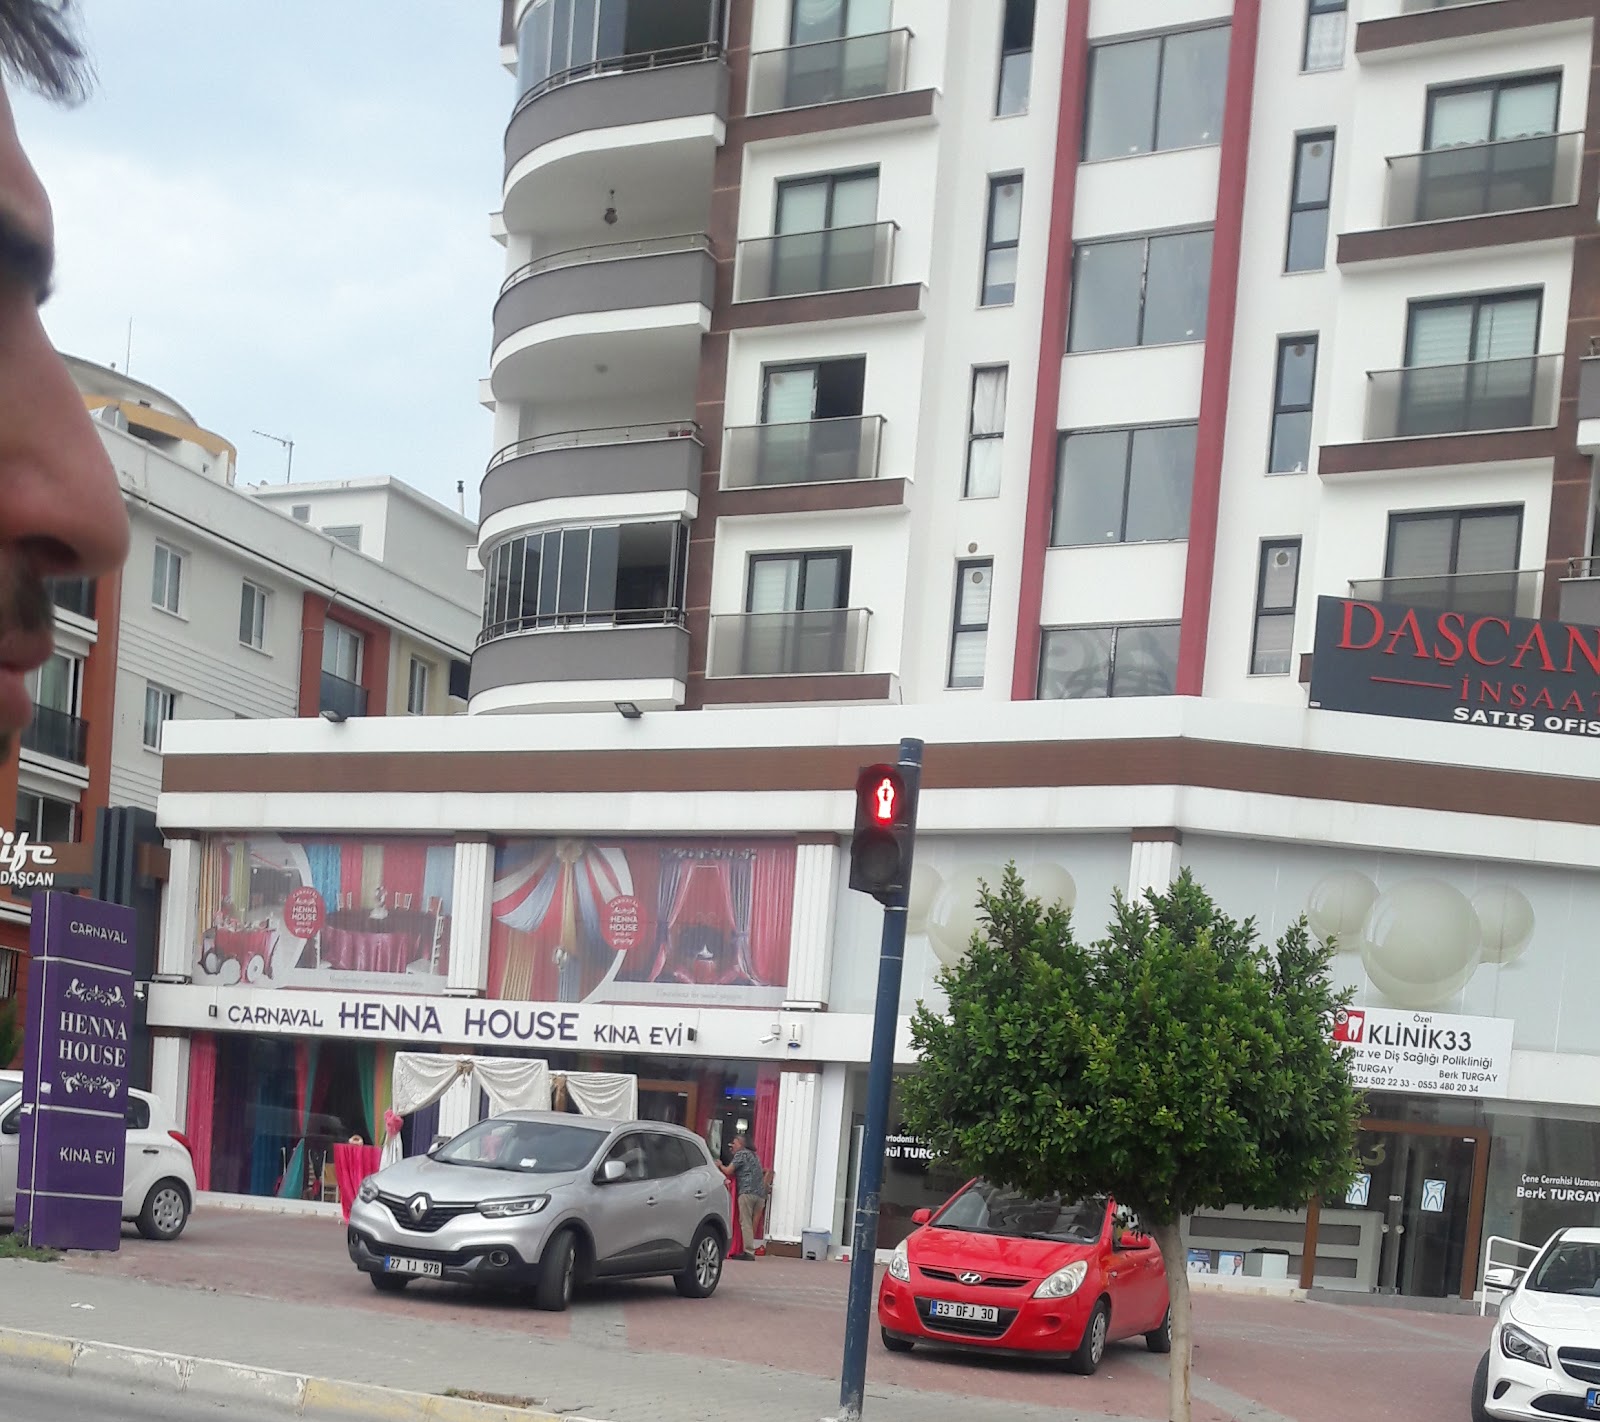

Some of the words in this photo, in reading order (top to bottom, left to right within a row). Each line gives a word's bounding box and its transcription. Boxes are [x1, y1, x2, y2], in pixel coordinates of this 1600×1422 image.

[1336, 600, 1600, 676] DAŞCAN
[1453, 707, 1534, 731] SATIŞ
[0, 827, 57, 872] ife
[0, 870, 54, 889] DAŞCAN
[70, 920, 128, 944] CARNAVAL
[60, 1010, 127, 1040] HENNA
[228, 1005, 323, 1027] CARNAVAL
[339, 1001, 442, 1034] HENNA
[464, 1007, 580, 1041] HOUSE
[594, 1023, 641, 1045] KINA
[650, 1022, 683, 1046] EVİ
[1413, 1013, 1433, 1024] Özel
[1368, 1022, 1472, 1051] KLİNİK33
[59, 1038, 127, 1068] HOUSE
[1367, 1050, 1381, 1059] ve
[1384, 1050, 1400, 1063] Diş
[1403, 1051, 1439, 1066] Sağlığı
[1442, 1054, 1493, 1070] Polikliniği
[1356, 1063, 1394, 1074] TURGAY
[1439, 1069, 1459, 1080] Berk
[1461, 1071, 1498, 1083] TURGAY
[1353, 1075, 1369, 1084] 324
[1370, 1076, 1386, 1086] 502
[1387, 1078, 1398, 1087] 22
[1399, 1079, 1410, 1088] 33
[1417, 1080, 1438, 1090] 0553
[1439, 1082, 1455, 1091] 480
[1456, 1084, 1467, 1092] 20
[1468, 1084, 1479, 1093] 34
[60, 1146, 91, 1163] KINA
[95, 1147, 115, 1166] EVİ
[885, 1146, 901, 1158] tül
[1521, 1173, 1540, 1185] Çene
[1540, 1174, 1573, 1186] Cerrahisi
[1516, 1186, 1547, 1200] Berk
[1550, 1188, 1600, 1203] TURGAY
[391, 1258, 401, 1269] 27
[407, 1260, 417, 1272] TJ
[423, 1262, 440, 1274] 978
[938, 1303, 950, 1315] 33
[956, 1305, 975, 1318] DFJ
[981, 1308, 994, 1320] 30
